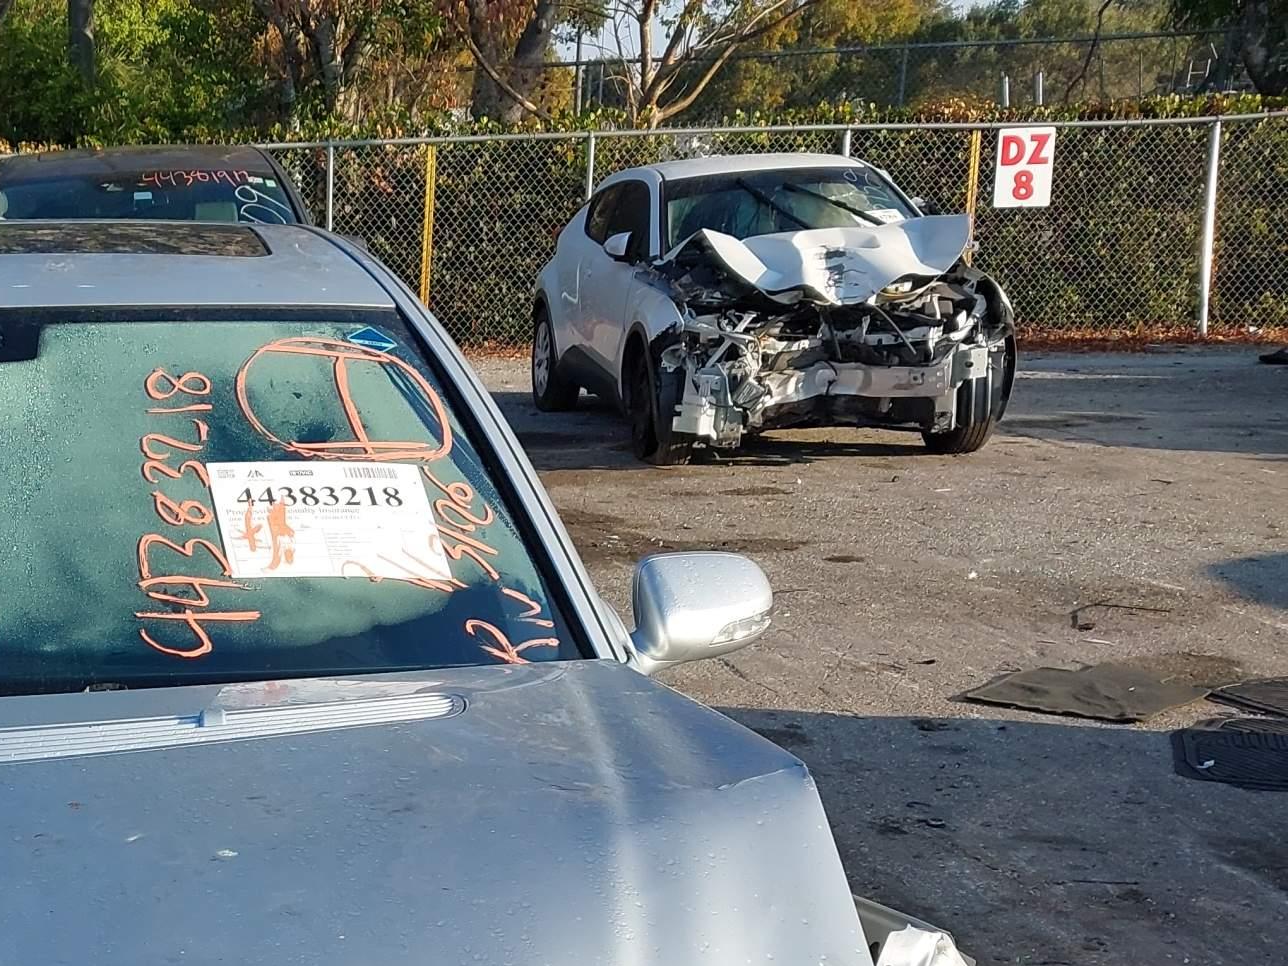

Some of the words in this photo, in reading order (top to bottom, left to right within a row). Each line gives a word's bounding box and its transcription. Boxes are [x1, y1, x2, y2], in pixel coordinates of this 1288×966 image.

[1001, 133, 1052, 166] DZ
[1012, 170, 1034, 200] 8
[237, 486, 404, 507] 44383218
